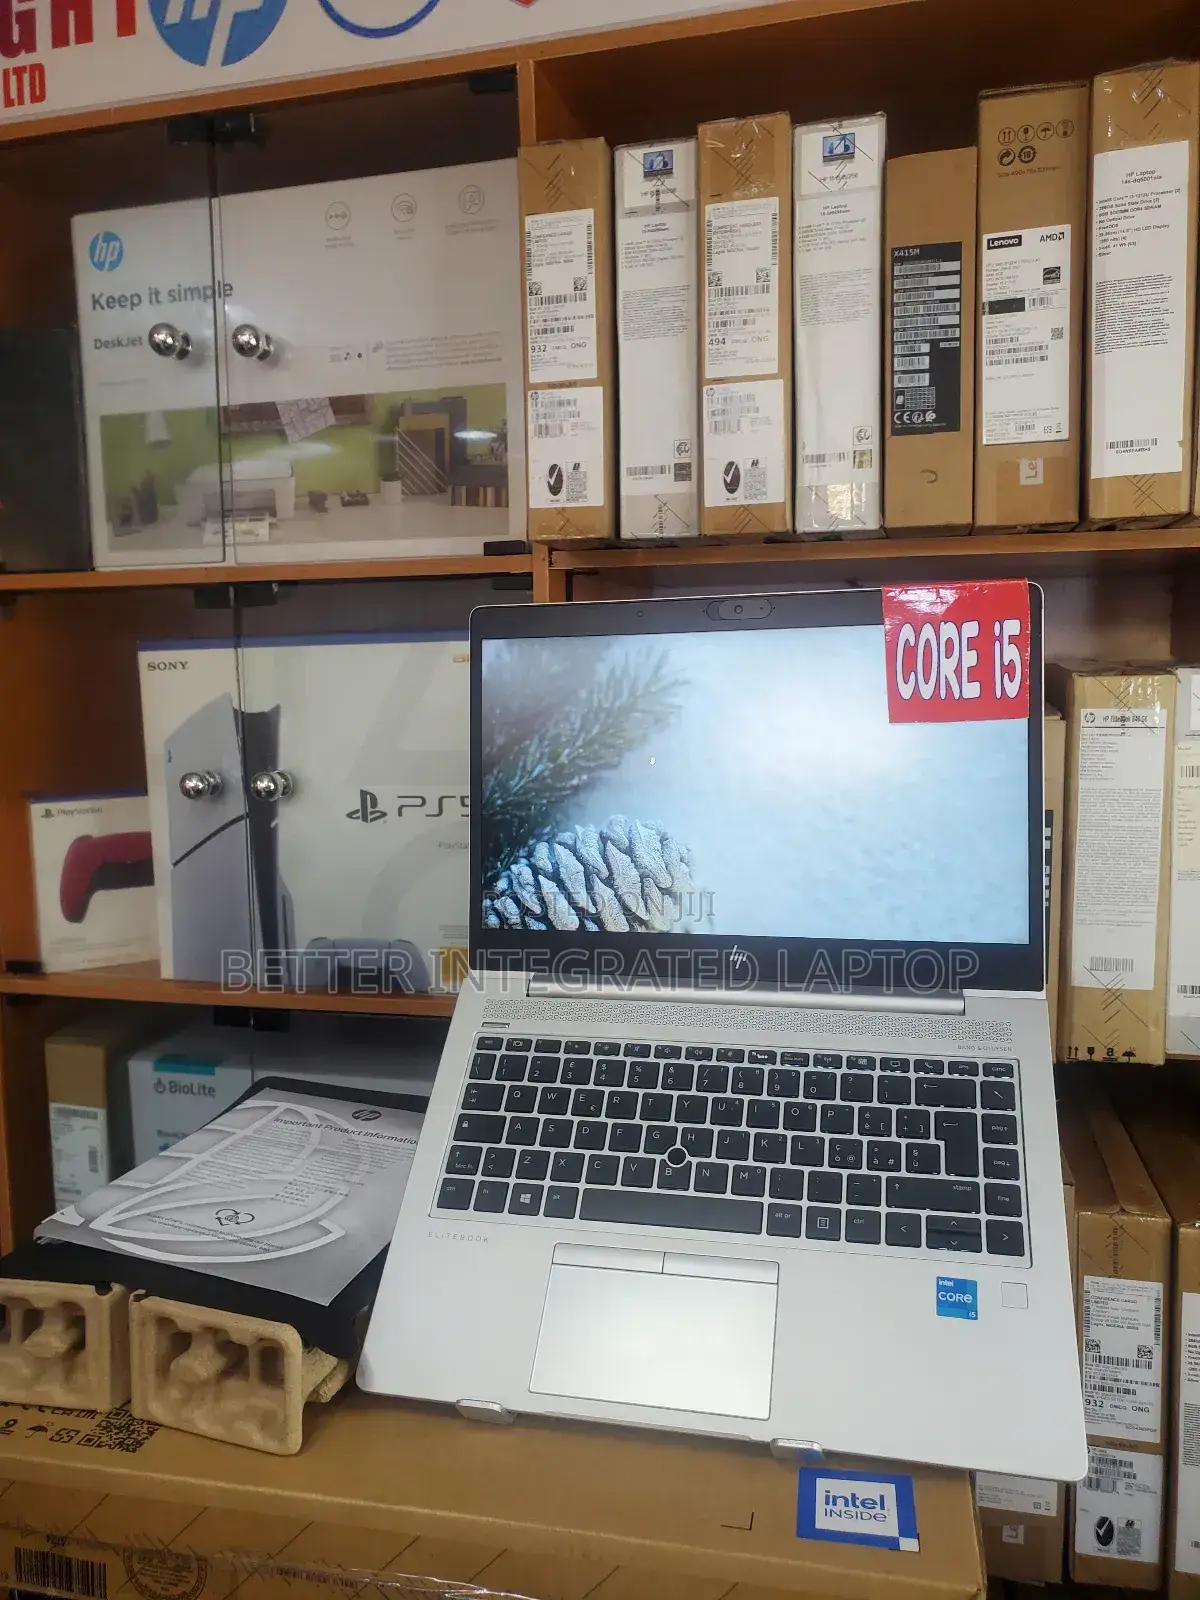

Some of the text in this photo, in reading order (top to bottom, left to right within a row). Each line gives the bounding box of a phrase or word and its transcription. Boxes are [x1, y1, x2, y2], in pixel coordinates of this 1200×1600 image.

[2, 62, 46, 108] LTD
[990, 237, 1019, 247] Lenovo
[1040, 234, 1057, 242] AMD
[89, 231, 124, 272] hp
[894, 248, 920, 257] X415M
[91, 280, 234, 311] Keep it simple
[93, 335, 144, 350] DeskJet
[708, 337, 726, 346] 494
[530, 344, 547, 353] 932
[896, 618, 1022, 701] CORE i5
[147, 660, 189, 672] SONY
[438, 840, 470, 850] PlaySta
[168, 1080, 217, 1097] BioLite
[579, 1094, 586, 1102] E
[718, 1103, 726, 1111] U
[791, 1107, 800, 1116] O
[273, 1117, 419, 1145] Important Product Informatio
[616, 1128, 623, 1136] F
[761, 1139, 768, 1147] K
[798, 1141, 804, 1150] L
[559, 1158, 566, 1167] X
[594, 1160, 602, 1169] C
[665, 1167, 672, 1176] B
[702, 1168, 710, 1177] N
[740, 1171, 748, 1180] M
[428, 1231, 490, 1243] ELITEBOOK
[938, 1278, 954, 1287] intel
[1085, 1398, 1104, 1408] 932
[824, 1489, 886, 1511] intel
